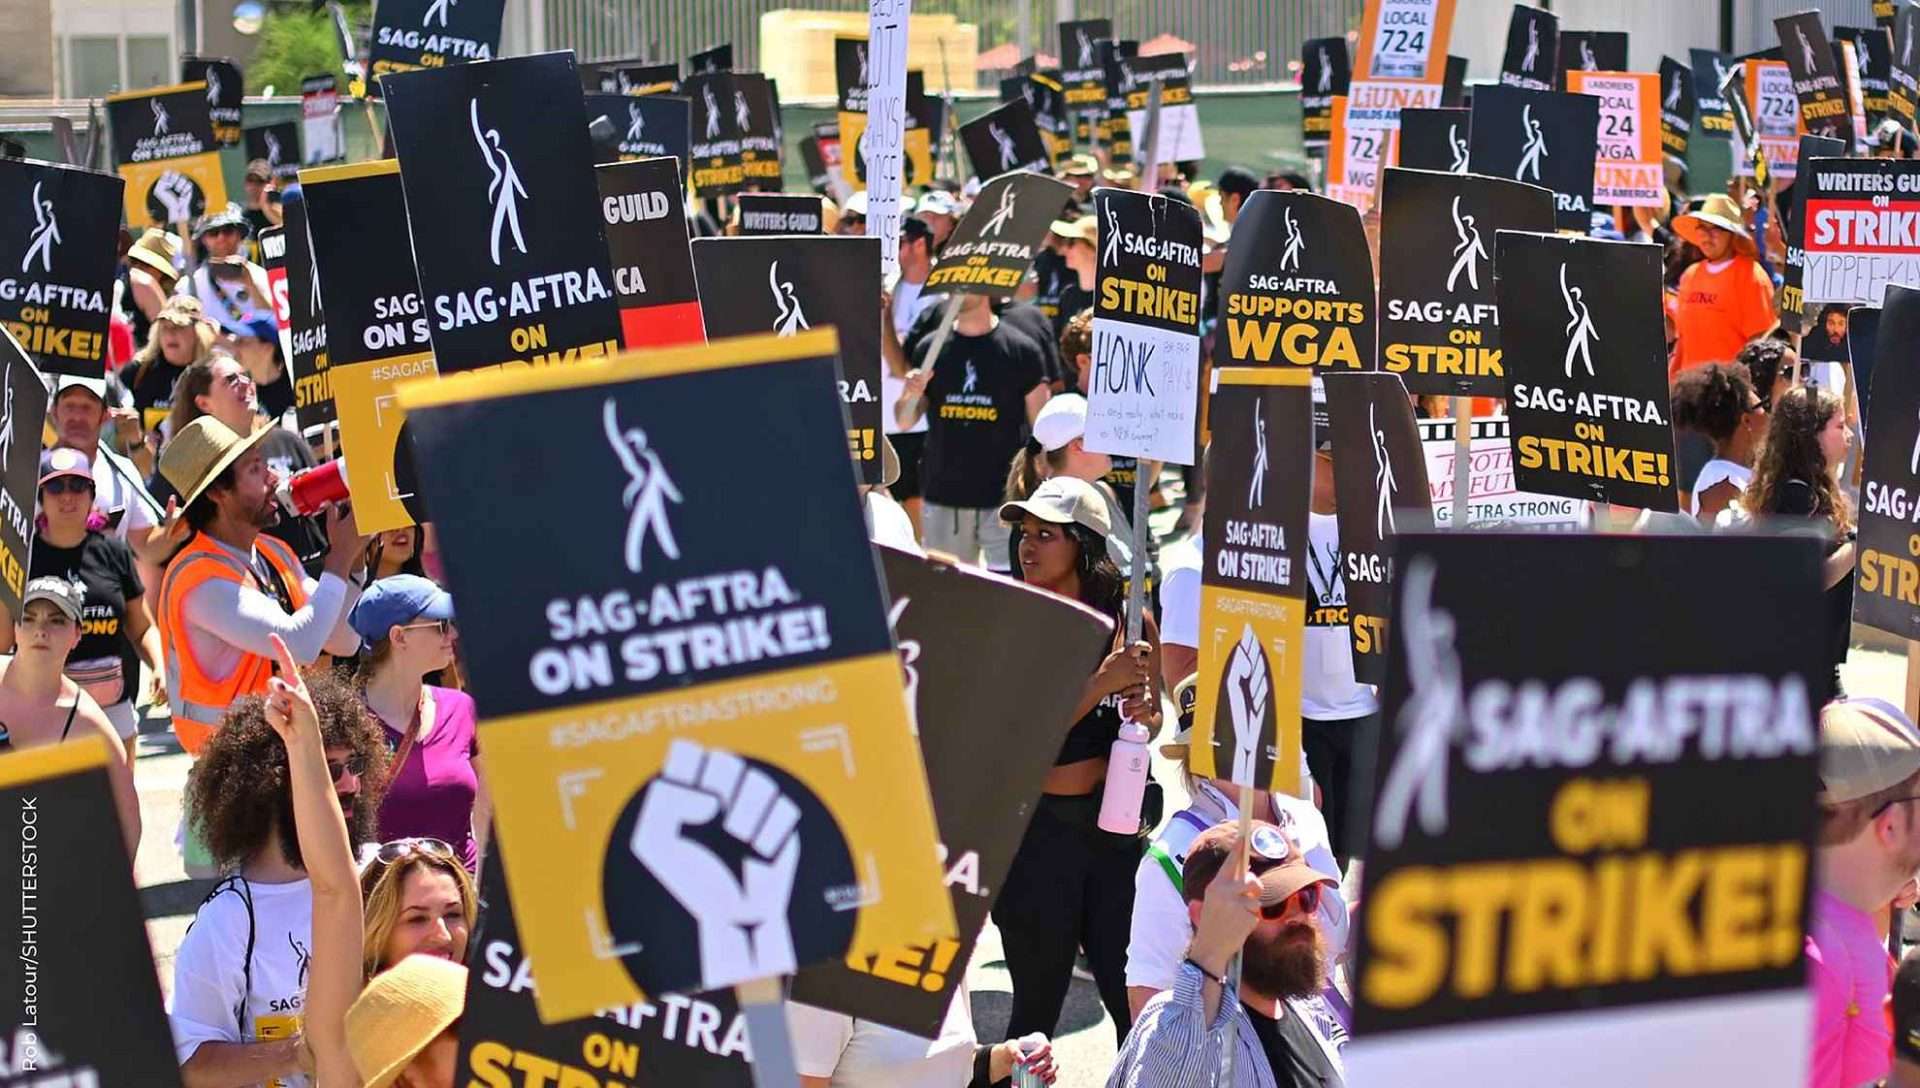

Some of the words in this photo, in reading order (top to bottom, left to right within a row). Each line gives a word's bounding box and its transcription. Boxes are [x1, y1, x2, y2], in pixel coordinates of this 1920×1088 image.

[1384, 12, 1427, 25] LOCAL
[1382, 30, 1424, 53] 724
[1588, 81, 1634, 91] LABORERS
[1762, 97, 1794, 117] 724
[1599, 115, 1634, 137] 24
[1348, 170, 1375, 187] WG
[1817, 173, 1894, 192] WRITERS
[1611, 188, 1659, 199] AMERICA
[1872, 195, 1889, 207] ON
[603, 191, 669, 225] GUILD
[743, 211, 788, 232] WRITERS
[788, 213, 818, 233] GUILD
[966, 256, 988, 267] ON
[613, 266, 647, 296] CA
[926, 267, 1022, 288] STRIKE!
[1146, 263, 1166, 283] ON
[1101, 276, 1198, 326] STRIKE!
[1228, 294, 1364, 324] SUPPORTS
[20, 307, 49, 323] ON
[363, 323, 406, 349] ON
[510, 324, 548, 353] ON
[1227, 319, 1361, 369] WGA
[1449, 329, 1481, 345] ON
[1094, 331, 1155, 397] HONK
[940, 405, 997, 421] STRONG
[1575, 422, 1605, 442] ON
[1518, 436, 1670, 487] STRIKE!
[1509, 500, 1571, 517] STRONG
[1217, 549, 1238, 577] ON
[1241, 553, 1291, 585] STRIKE!
[529, 647, 613, 696] ON
[622, 605, 832, 683] STRIKE!
[549, 682, 837, 747] #SAGAFTRASTRONG
[1549, 775, 1652, 856] ON
[1360, 841, 1810, 1010] STRIKE!
[583, 1033, 640, 1080] ON
